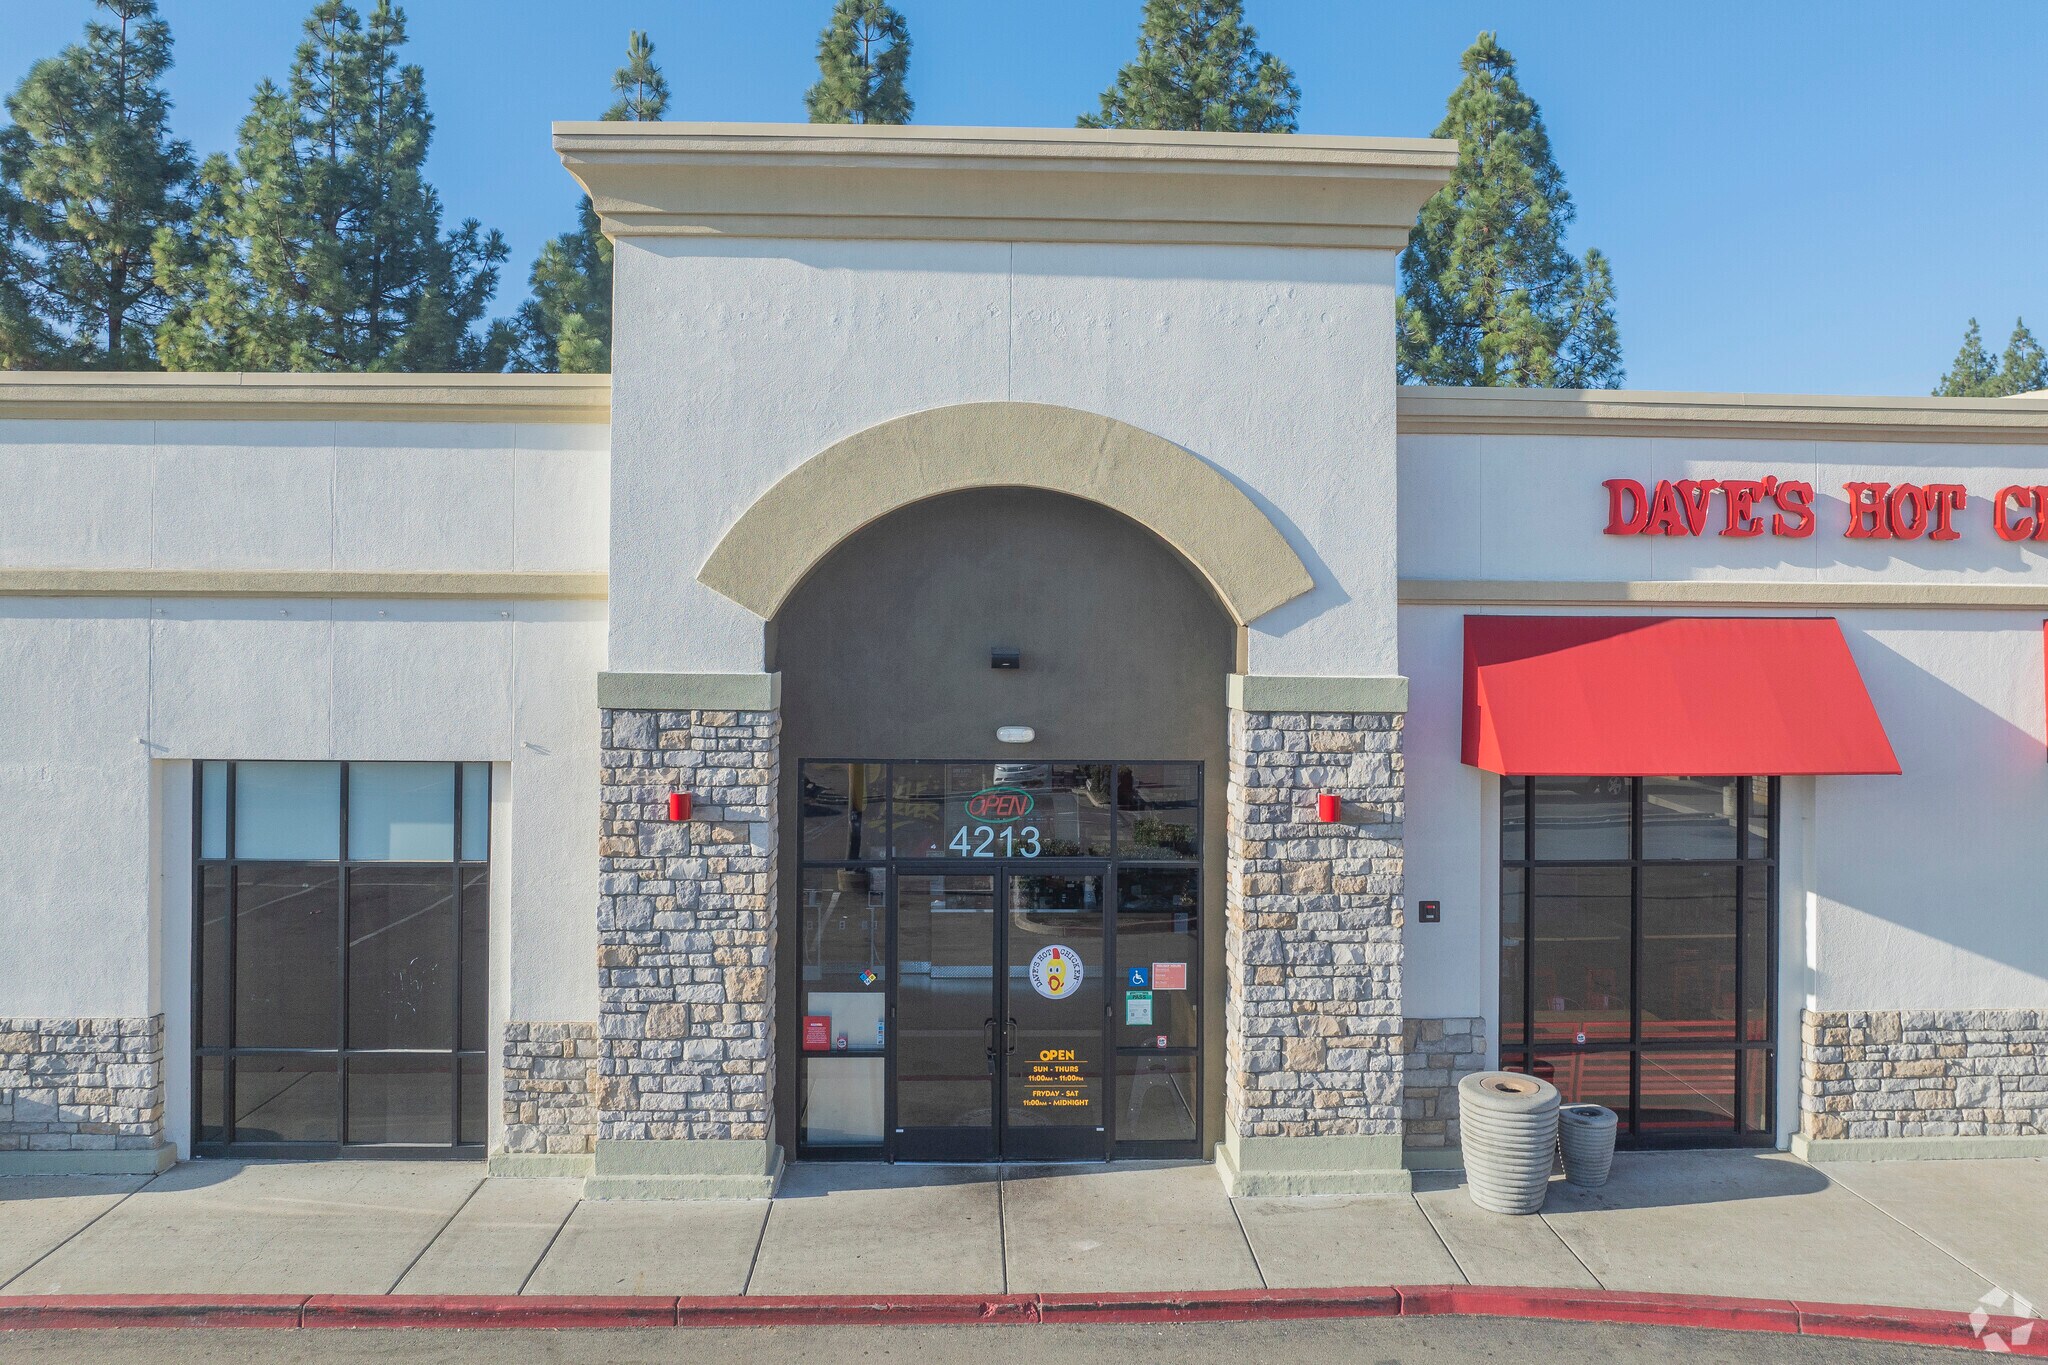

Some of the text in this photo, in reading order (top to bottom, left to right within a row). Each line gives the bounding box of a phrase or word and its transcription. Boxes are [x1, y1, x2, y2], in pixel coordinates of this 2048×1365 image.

[1602, 475, 1815, 538] DAVE'S
[1843, 482, 1967, 541] HOT
[969, 795, 1028, 816] OPEN
[949, 825, 1041, 858] 4213
[1031, 949, 1081, 988] DAVE'S HOT CHICKEN
[1039, 1049, 1075, 1061] OPEN
